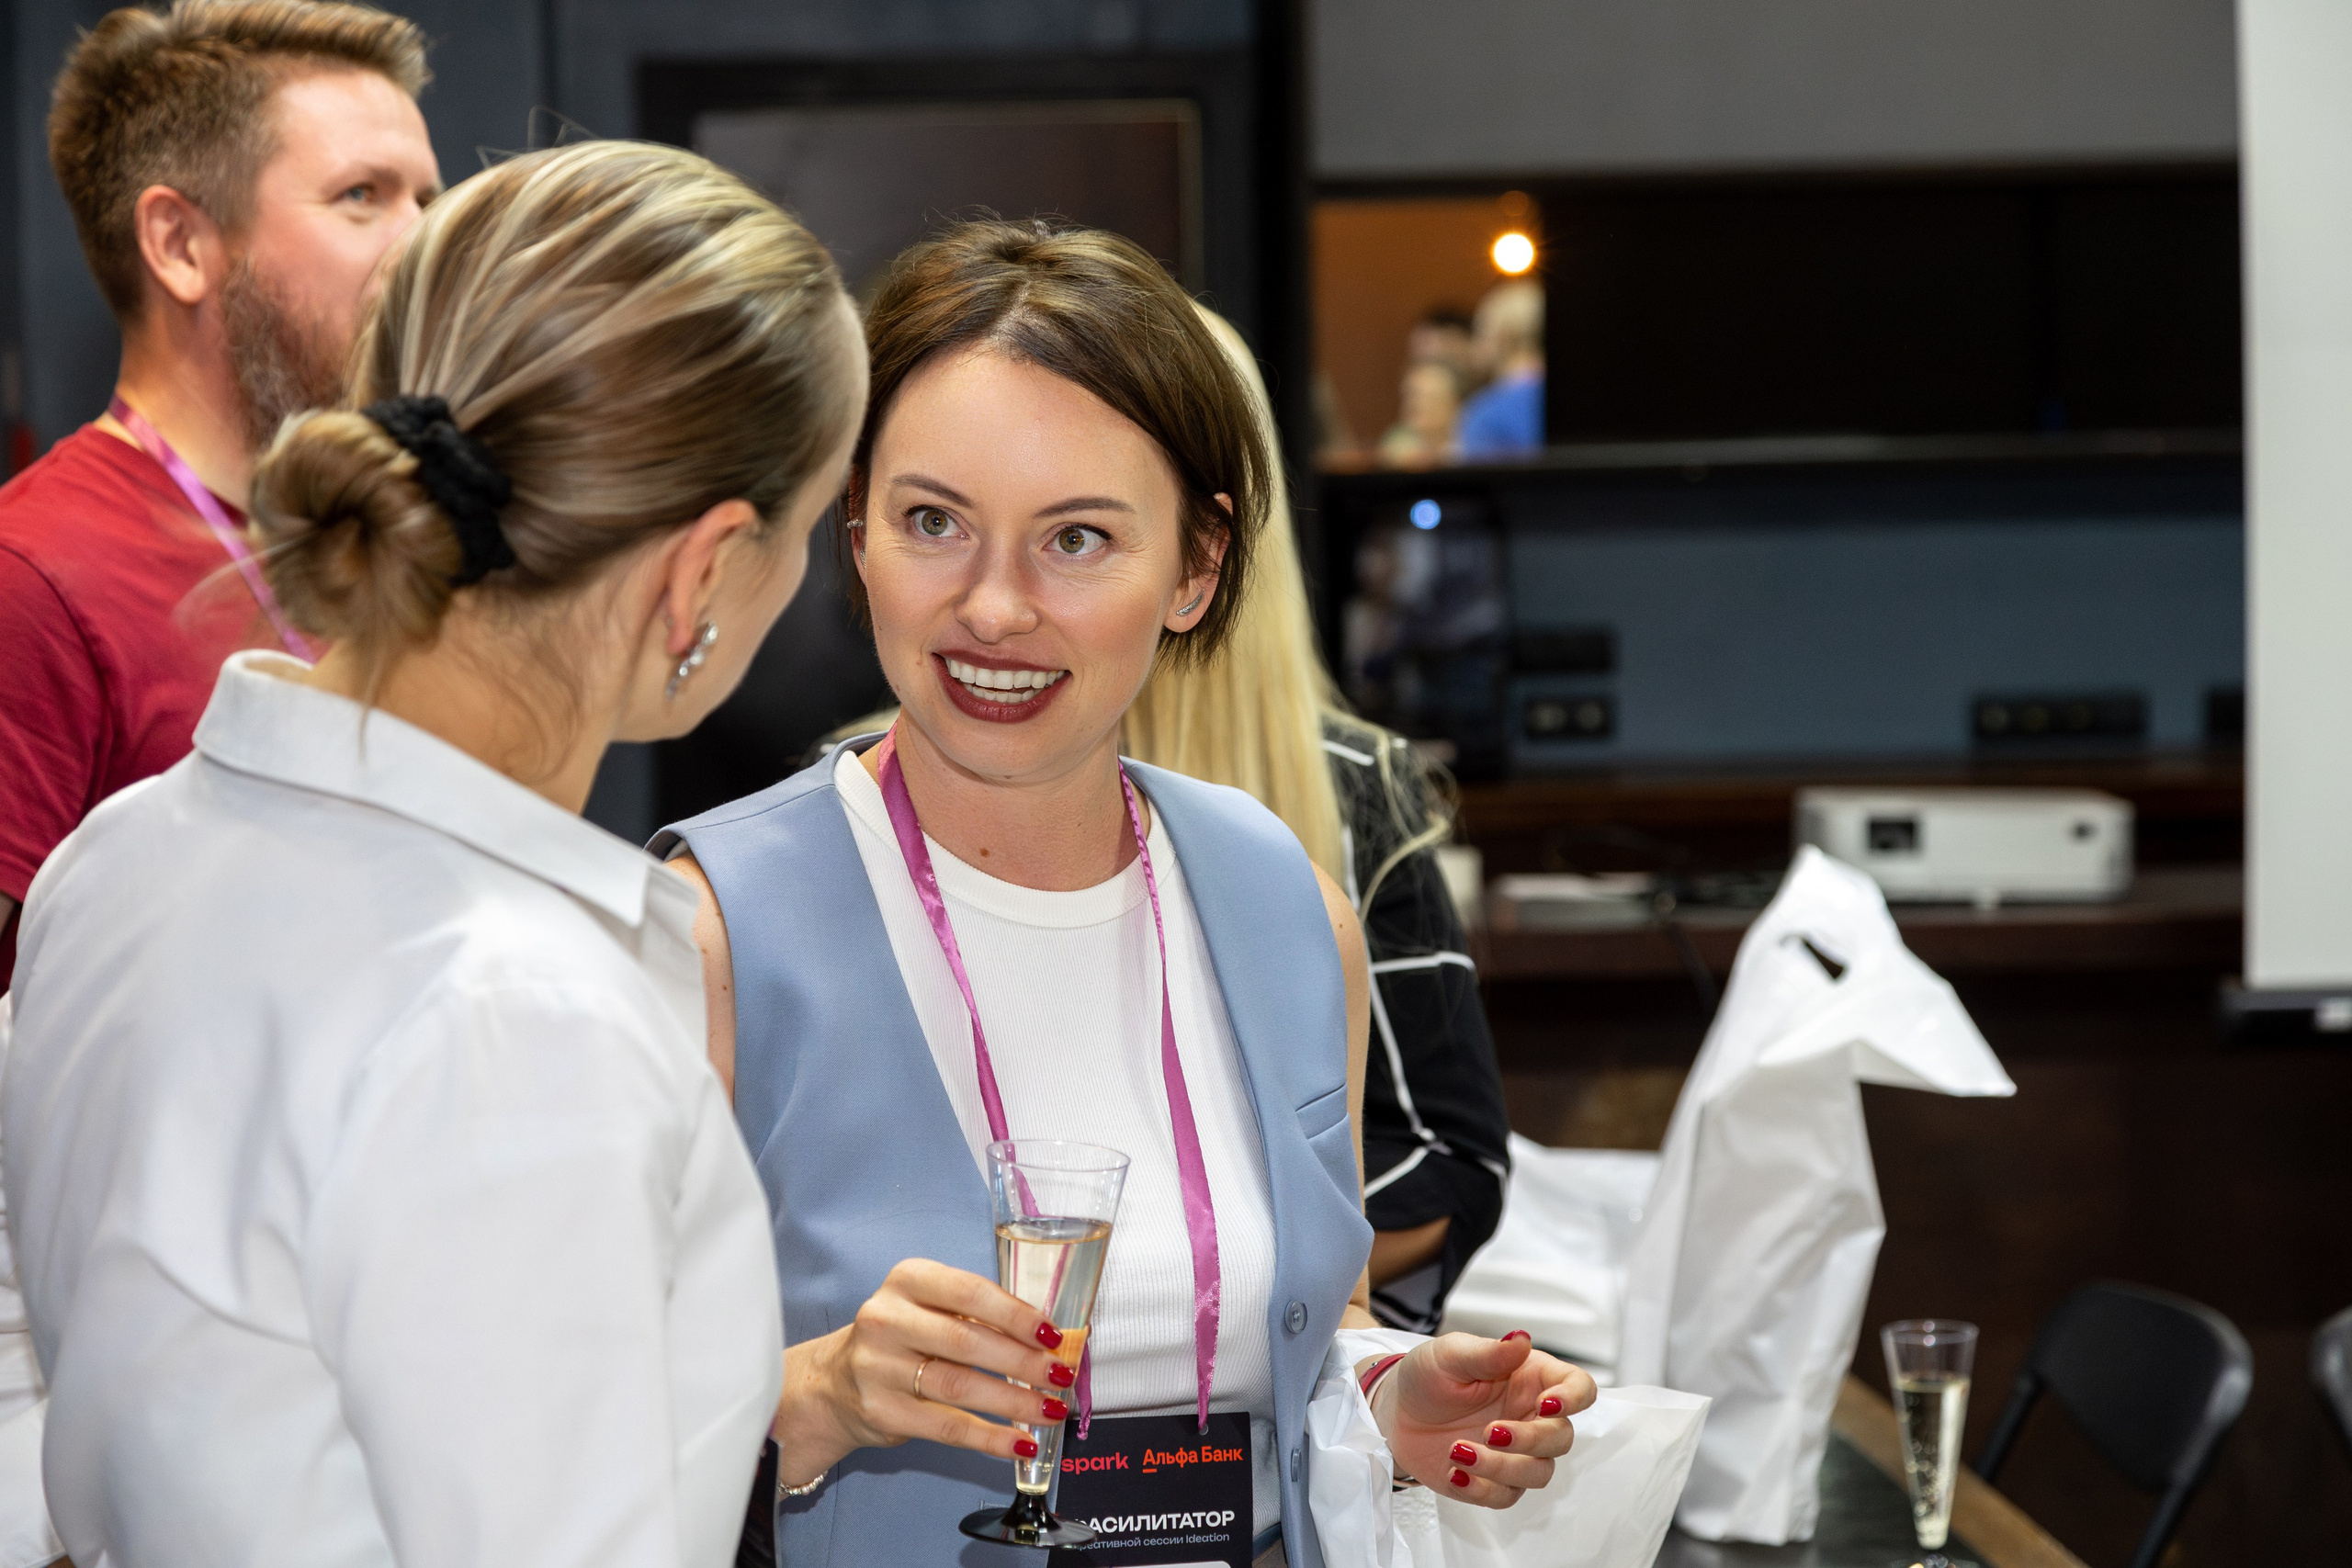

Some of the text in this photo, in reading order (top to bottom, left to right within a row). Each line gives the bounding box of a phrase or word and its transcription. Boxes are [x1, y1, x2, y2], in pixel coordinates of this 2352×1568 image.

[1061, 1451, 1129, 1475] spark
[1142, 1445, 1244, 1470] Альфа Банк
[1074, 1510, 1236, 1533] АСИЛИТАТОР
[1077, 1532, 1230, 1552] реативной сессии Ideation
